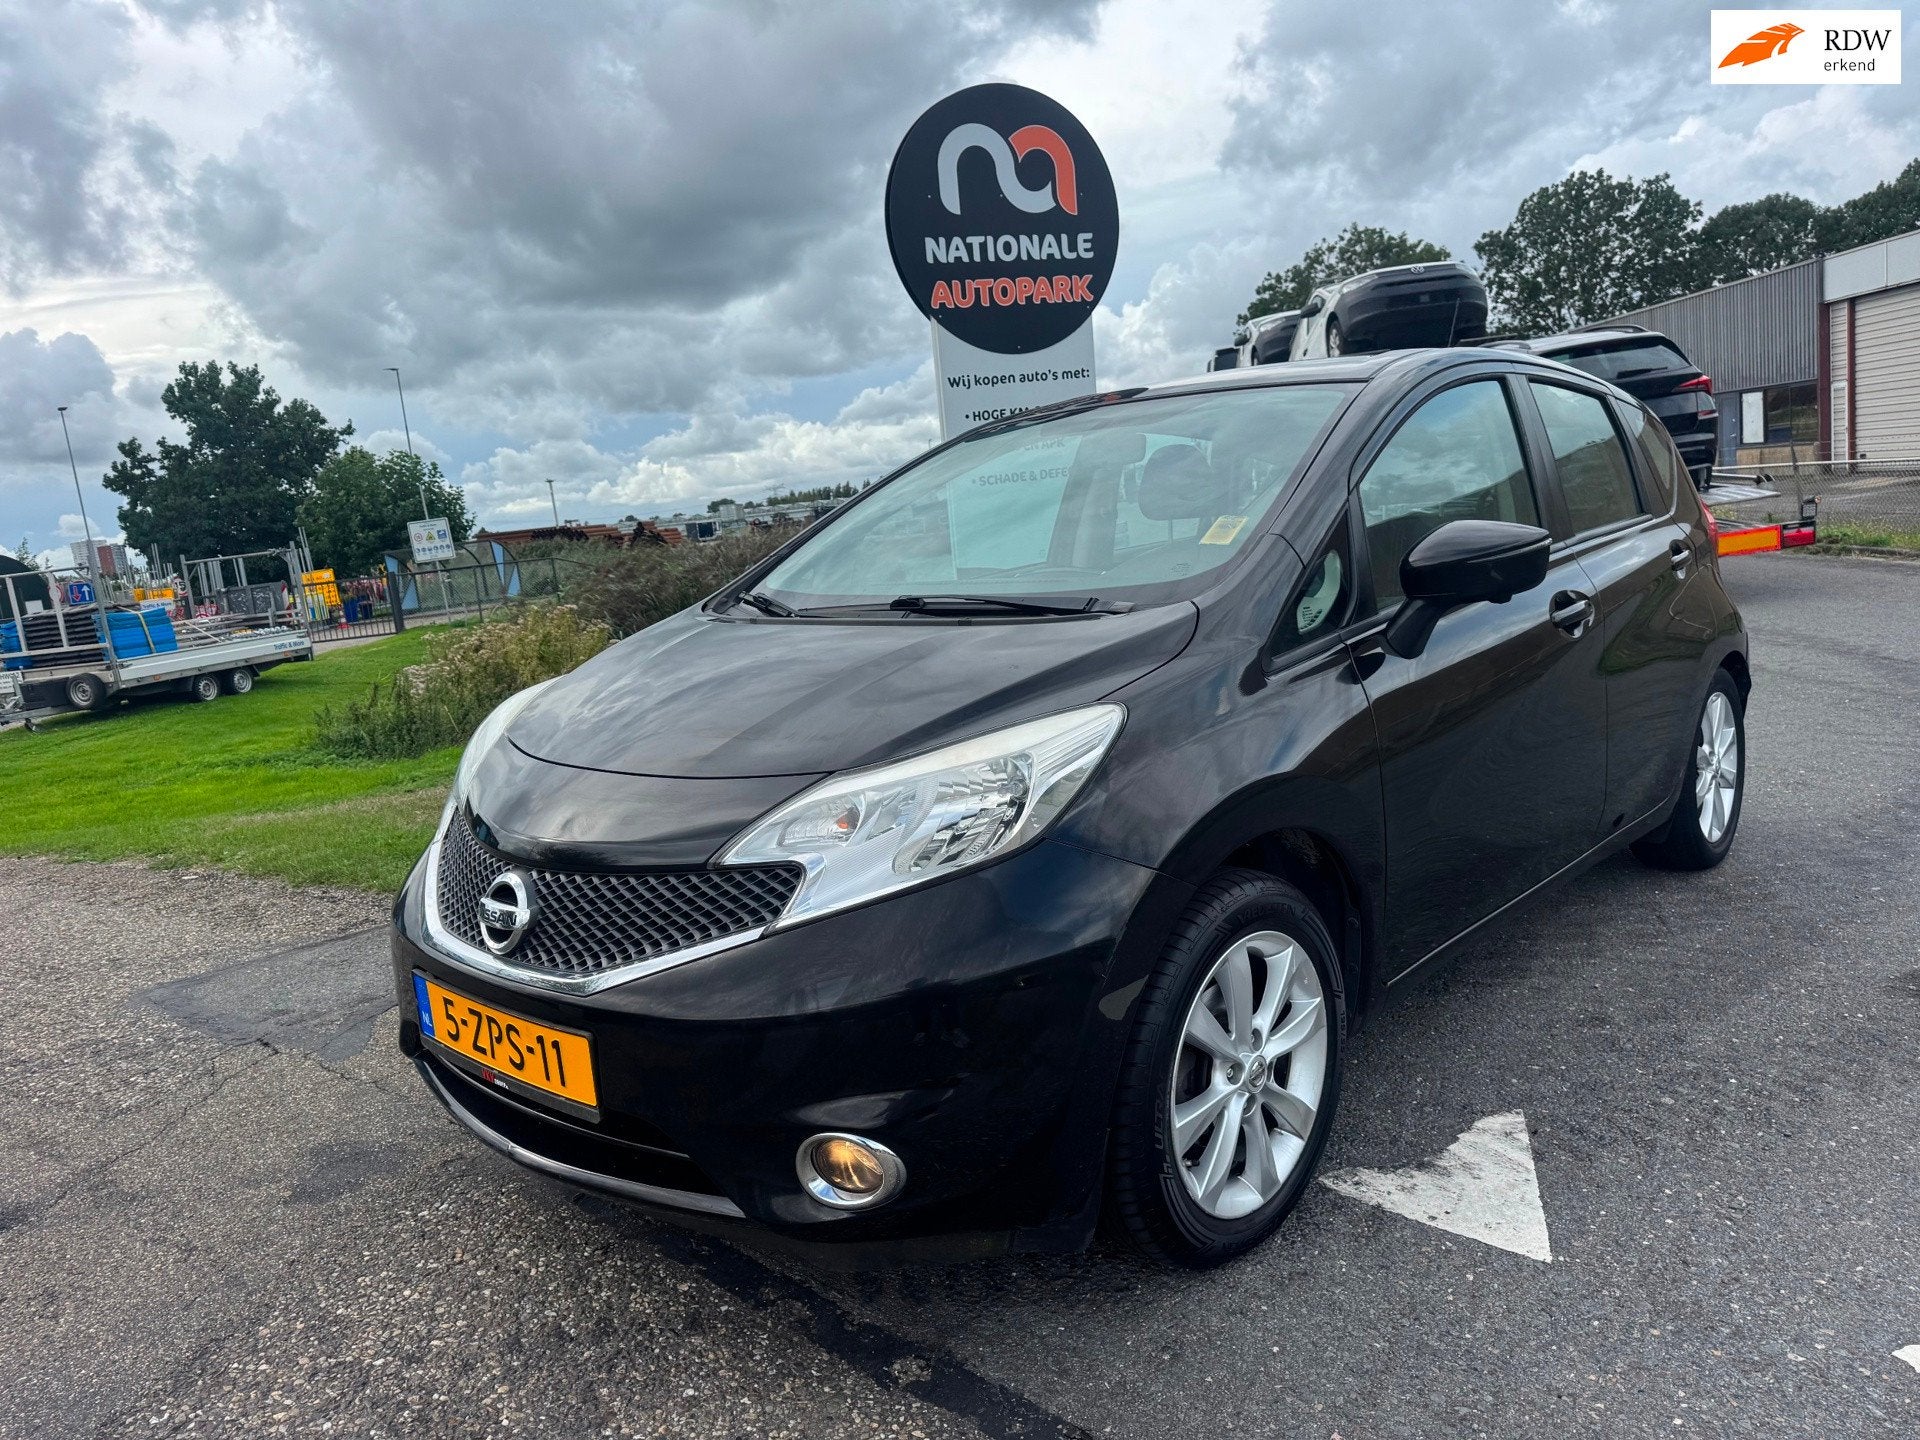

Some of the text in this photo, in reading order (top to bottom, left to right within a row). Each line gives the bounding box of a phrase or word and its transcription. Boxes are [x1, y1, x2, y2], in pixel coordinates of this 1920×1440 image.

[924, 232, 1094, 264] NATIONALE
[931, 274, 1094, 309] AUTOPARK
[947, 367, 1090, 389] Wij kopen auto's met:
[972, 408, 1006, 421] HOGE
[979, 471, 1026, 487] SCHADE
[1029, 470, 1038, 481] &
[422, 1011, 432, 1026] NL
[442, 996, 566, 1087] 5-ZPS-11
